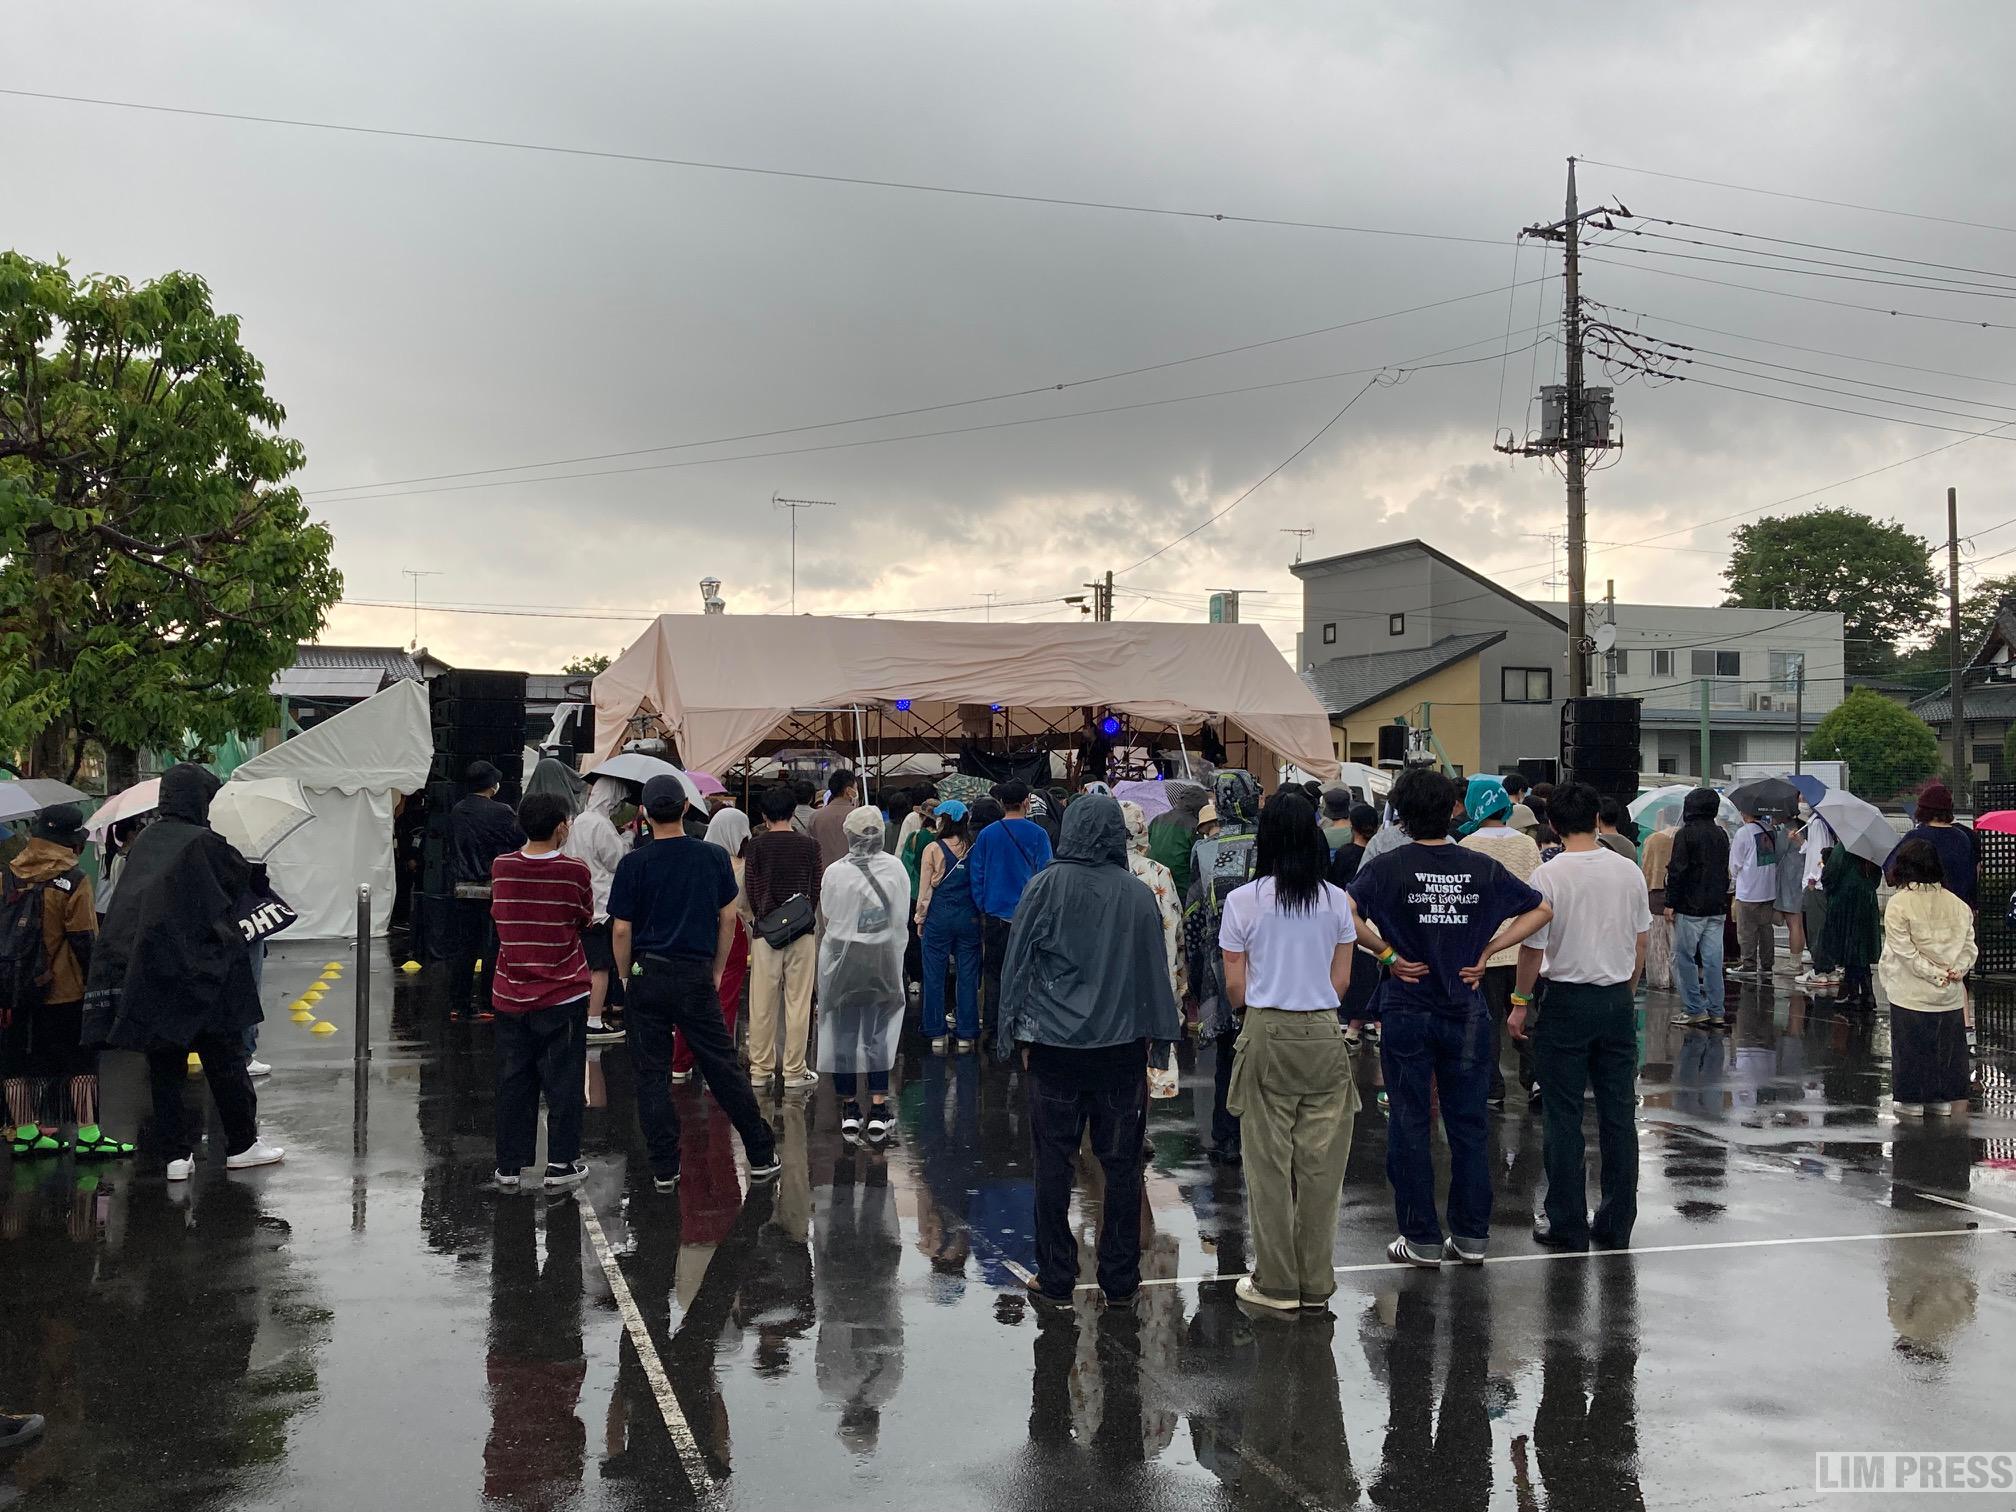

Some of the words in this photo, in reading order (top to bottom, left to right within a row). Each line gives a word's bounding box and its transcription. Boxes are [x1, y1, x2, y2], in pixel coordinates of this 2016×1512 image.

[1415, 872, 1472, 884] WITHOUT
[1425, 883, 1462, 893] MUSIC
[1430, 904, 1445, 914] BE
[1447, 904, 1457, 914] A
[1419, 914, 1469, 924] MISTAKE
